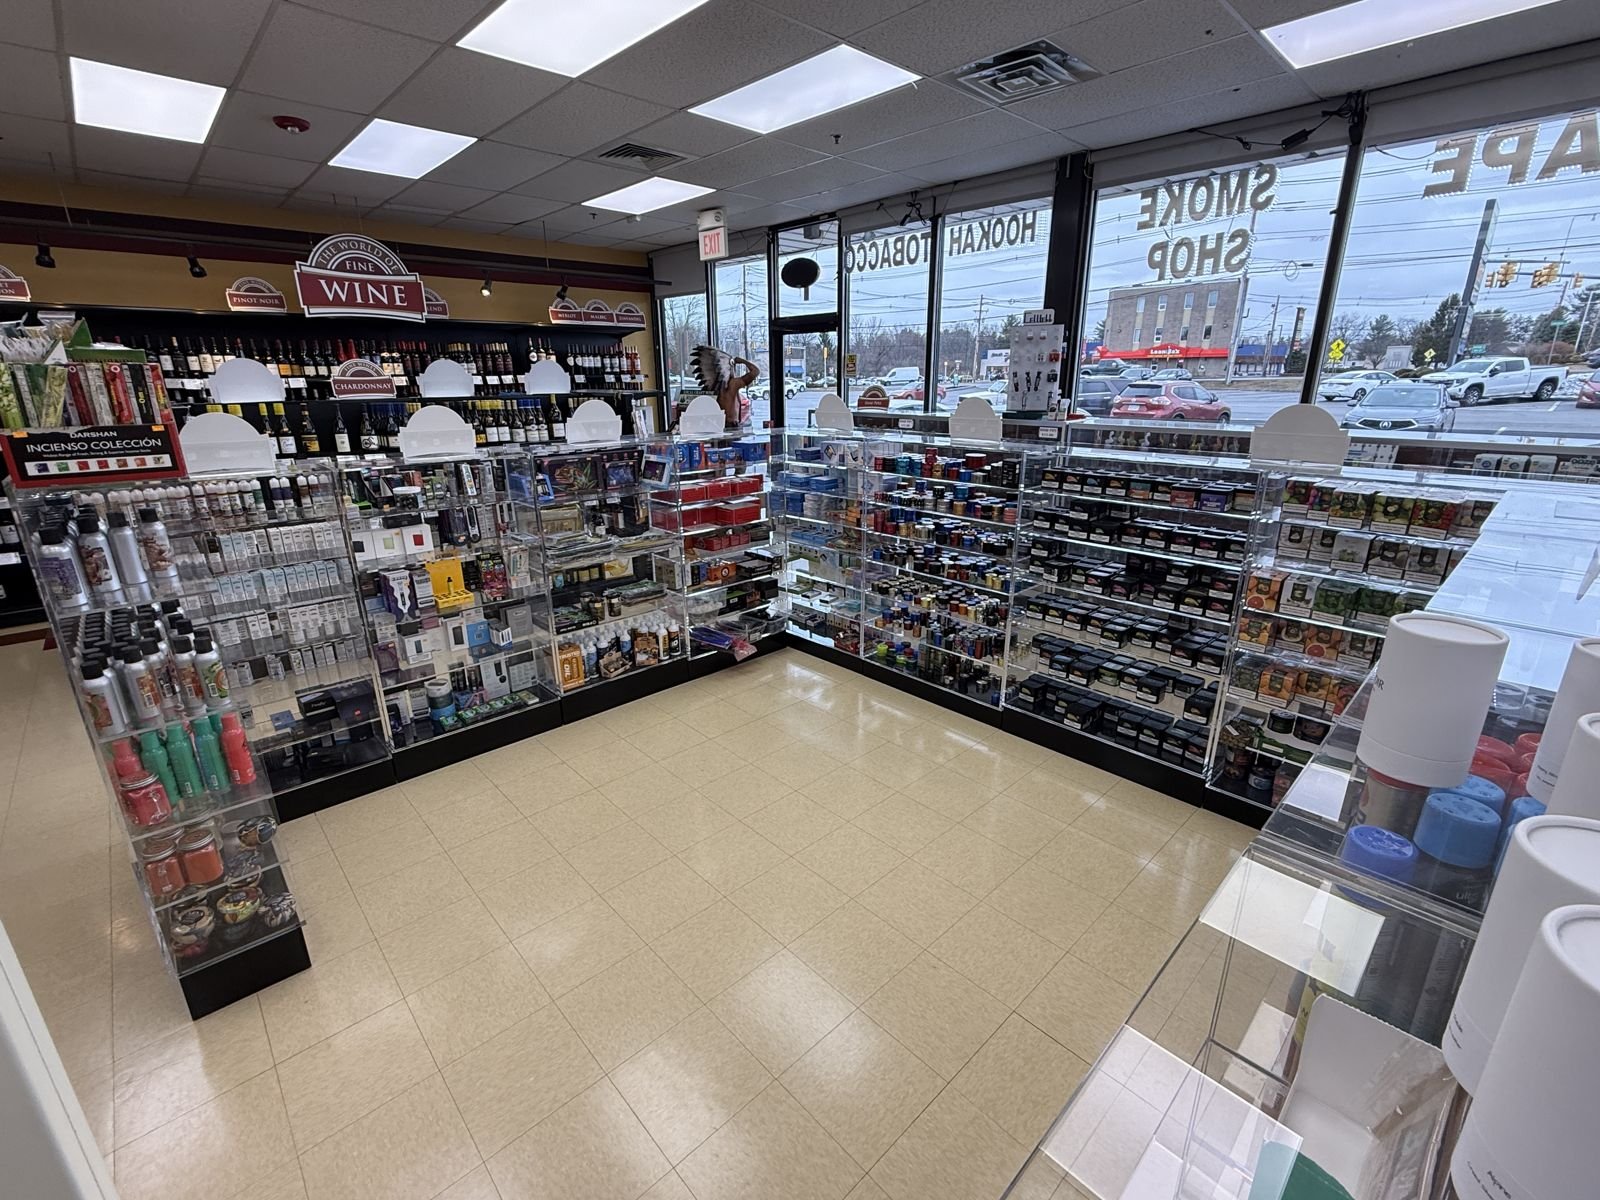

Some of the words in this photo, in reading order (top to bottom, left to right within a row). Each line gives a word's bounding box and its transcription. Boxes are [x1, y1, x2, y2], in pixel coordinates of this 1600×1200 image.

[317, 245, 338, 265] THE
[338, 240, 383, 257] WORLD
[384, 258, 400, 271] OF
[703, 232, 720, 256] EXIT
[345, 260, 375, 273] FINE
[318, 279, 408, 306] WINE
[26, 442, 88, 453] INCIENSO
[90, 436, 162, 450] COLECCIÓN
